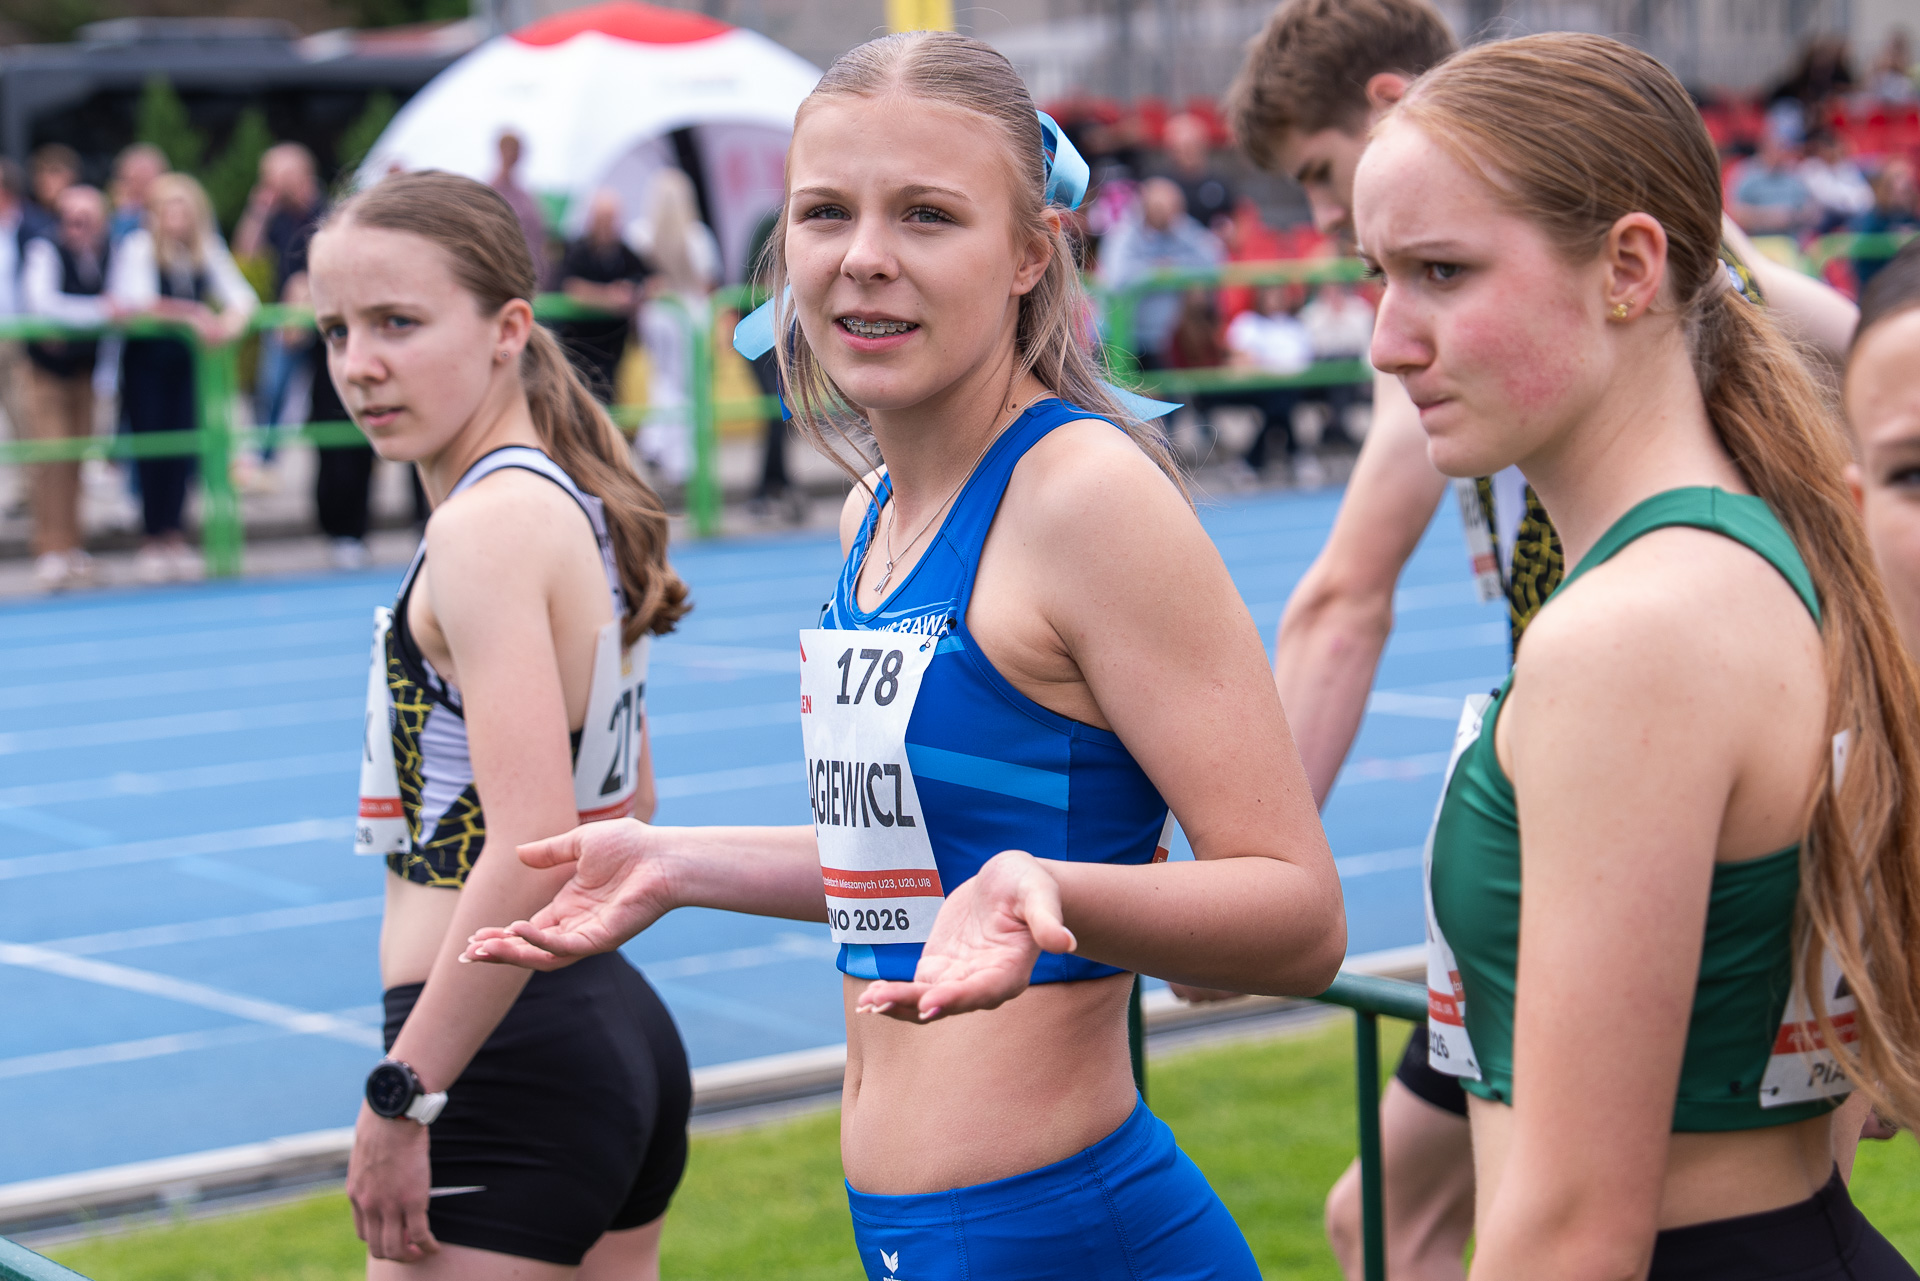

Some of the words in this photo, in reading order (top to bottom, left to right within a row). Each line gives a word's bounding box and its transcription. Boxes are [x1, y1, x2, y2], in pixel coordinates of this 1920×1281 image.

[836, 647, 904, 707] 178
[878, 879, 898, 890] U23,
[898, 878, 918, 889] U20,
[918, 878, 932, 888] U18
[854, 908, 910, 932] 2026
